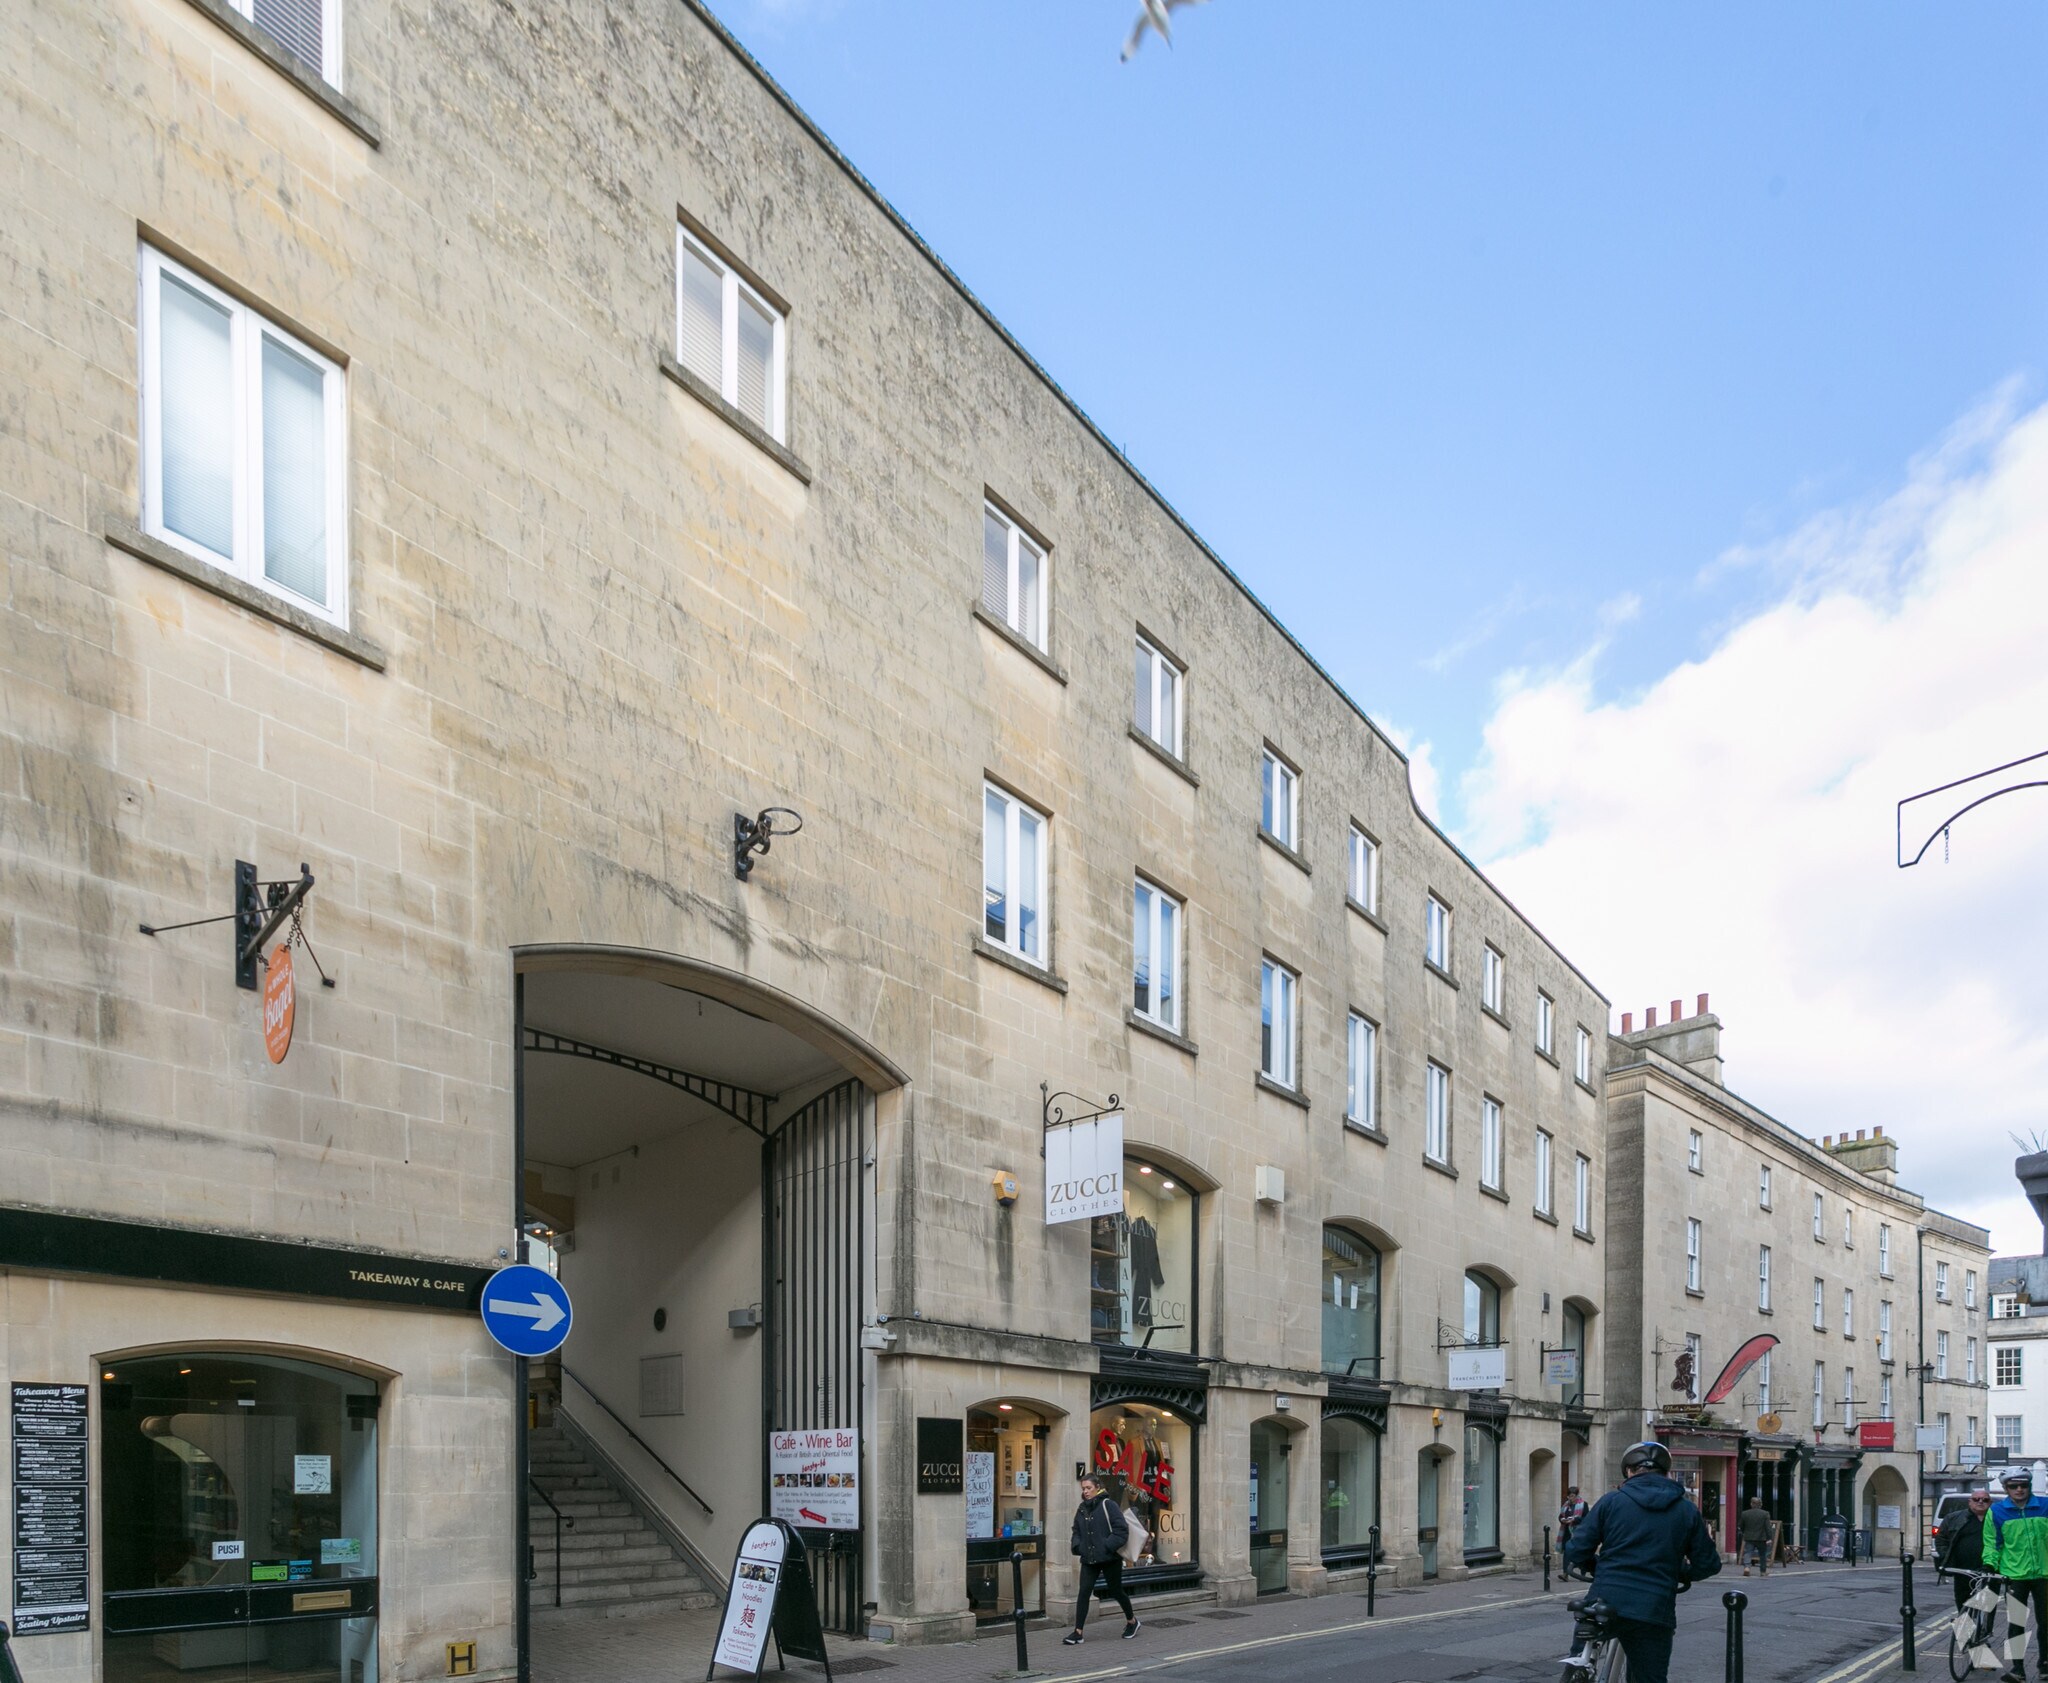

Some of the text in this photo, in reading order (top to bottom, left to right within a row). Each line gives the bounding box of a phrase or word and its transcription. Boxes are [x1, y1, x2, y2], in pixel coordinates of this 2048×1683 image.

[272, 964, 289, 990] WHOLE
[265, 969, 293, 1036] Bagel
[1050, 1172, 1118, 1204] ZUCCI
[1050, 1199, 1119, 1217] CLOTHES
[349, 1270, 465, 1292] TAKEAWAY & CAFE
[1138, 1296, 1187, 1322] ZUCCI
[13, 1386, 86, 1397] Takeaway Menu
[805, 1433, 832, 1449] Wine
[836, 1432, 853, 1448] Bar
[922, 1463, 961, 1476] ZUCCI
[1079, 1466, 1085, 1478] 7
[1095, 1428, 1175, 1504] SALE
[1160, 1513, 1186, 1534] CCI
[1160, 1536, 1187, 1545] THES
[217, 1545, 240, 1555] PUSH
[758, 1584, 768, 1593] Bar
[742, 1592, 763, 1604] Noodles
[17, 1613, 86, 1629] Seating Upstairs
[732, 1626, 756, 1640] Takeaway
[451, 1645, 473, 1674] H
